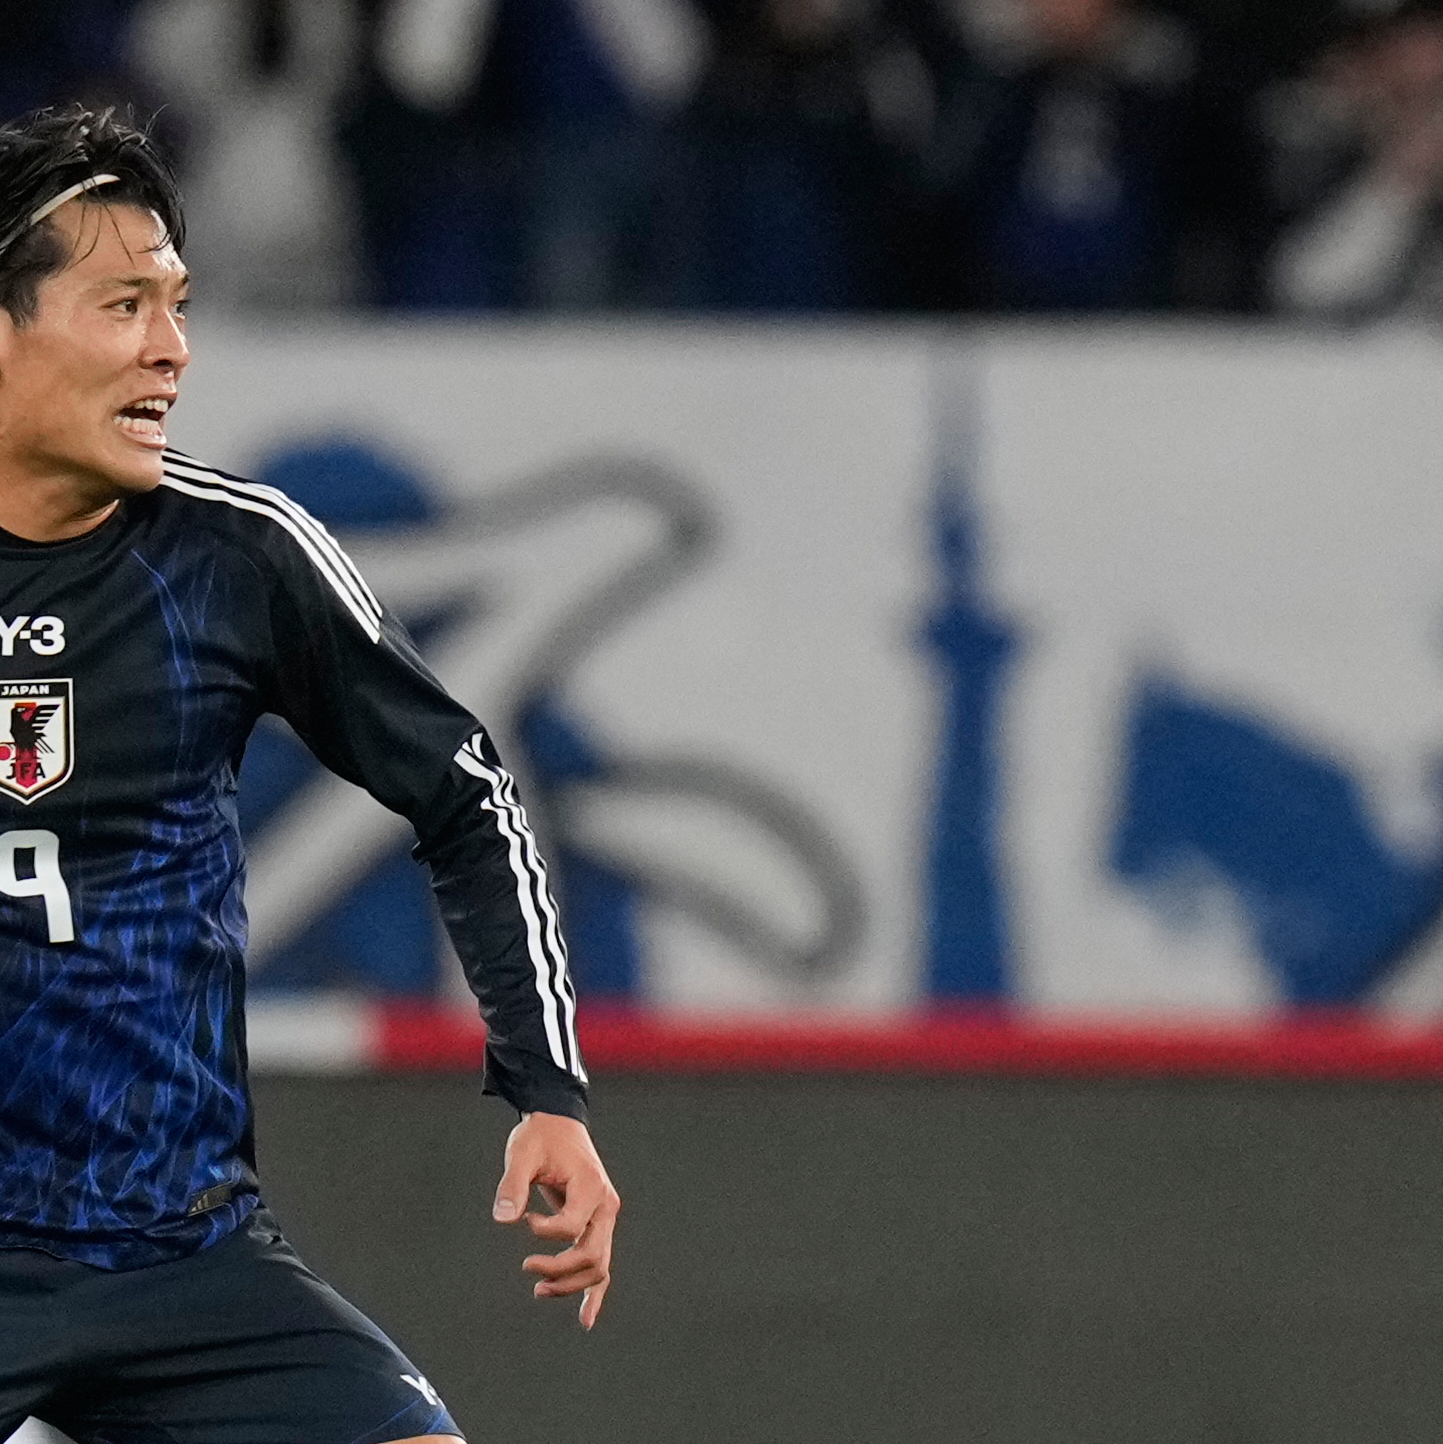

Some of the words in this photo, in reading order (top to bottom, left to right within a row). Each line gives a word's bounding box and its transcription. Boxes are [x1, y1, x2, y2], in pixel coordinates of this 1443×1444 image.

[1, 685, 50, 695] JAPAN
[5, 762, 46, 779] JFA
[400, 1374, 447, 1409] Y-
